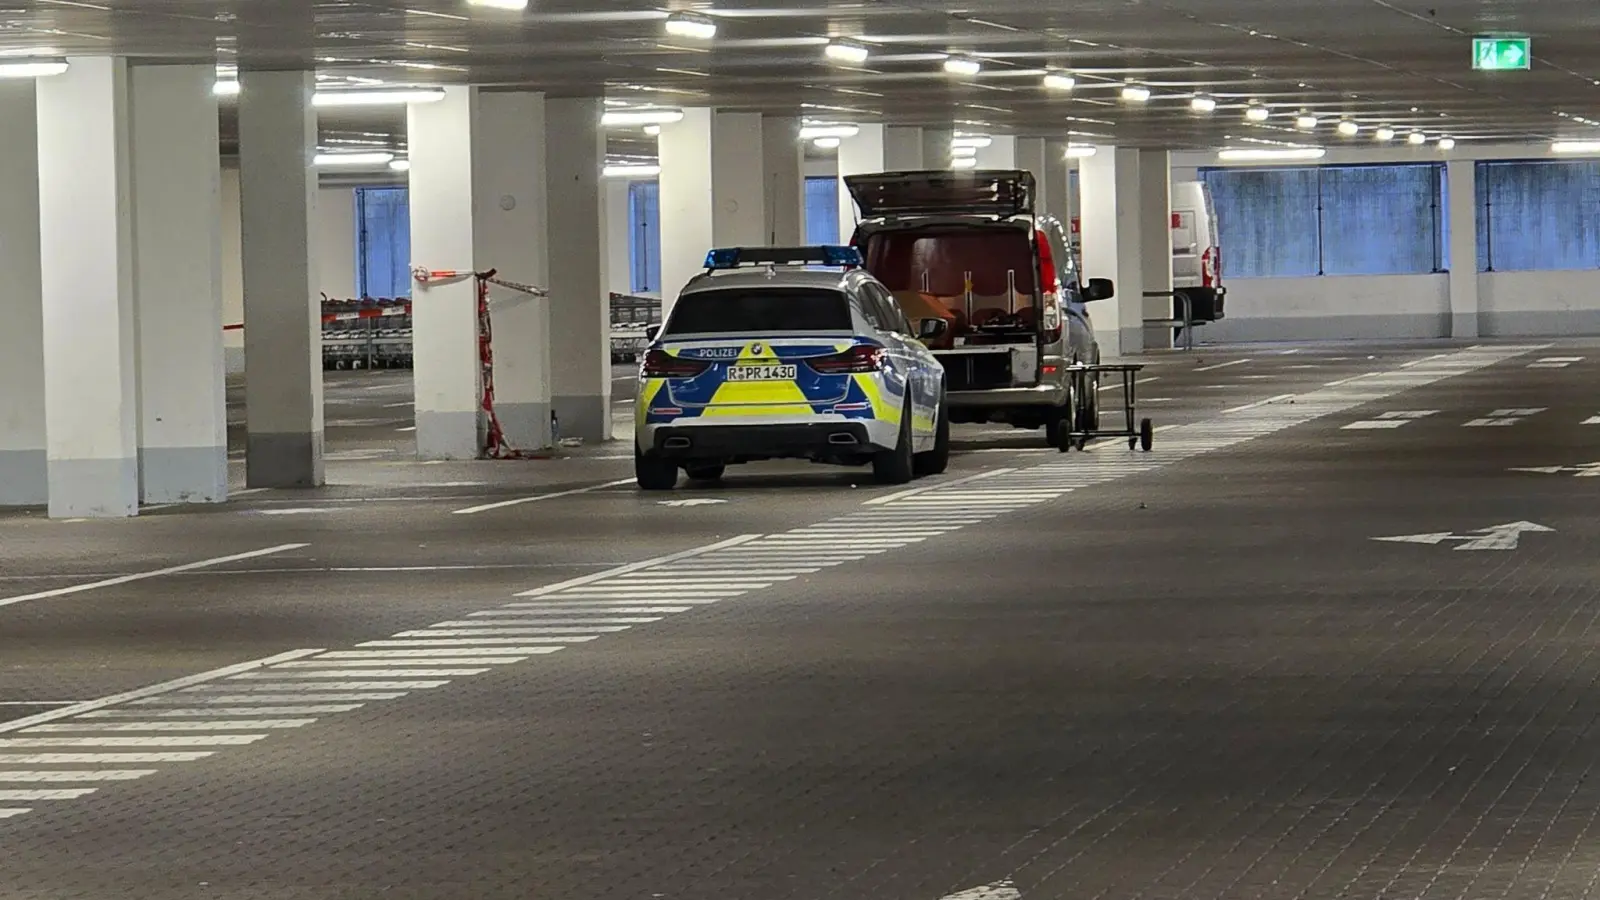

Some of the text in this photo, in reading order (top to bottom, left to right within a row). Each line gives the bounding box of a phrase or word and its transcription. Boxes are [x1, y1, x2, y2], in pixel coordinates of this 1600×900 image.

[700, 348, 737, 357] POLIZEI
[728, 366, 795, 379] R PR 1430
